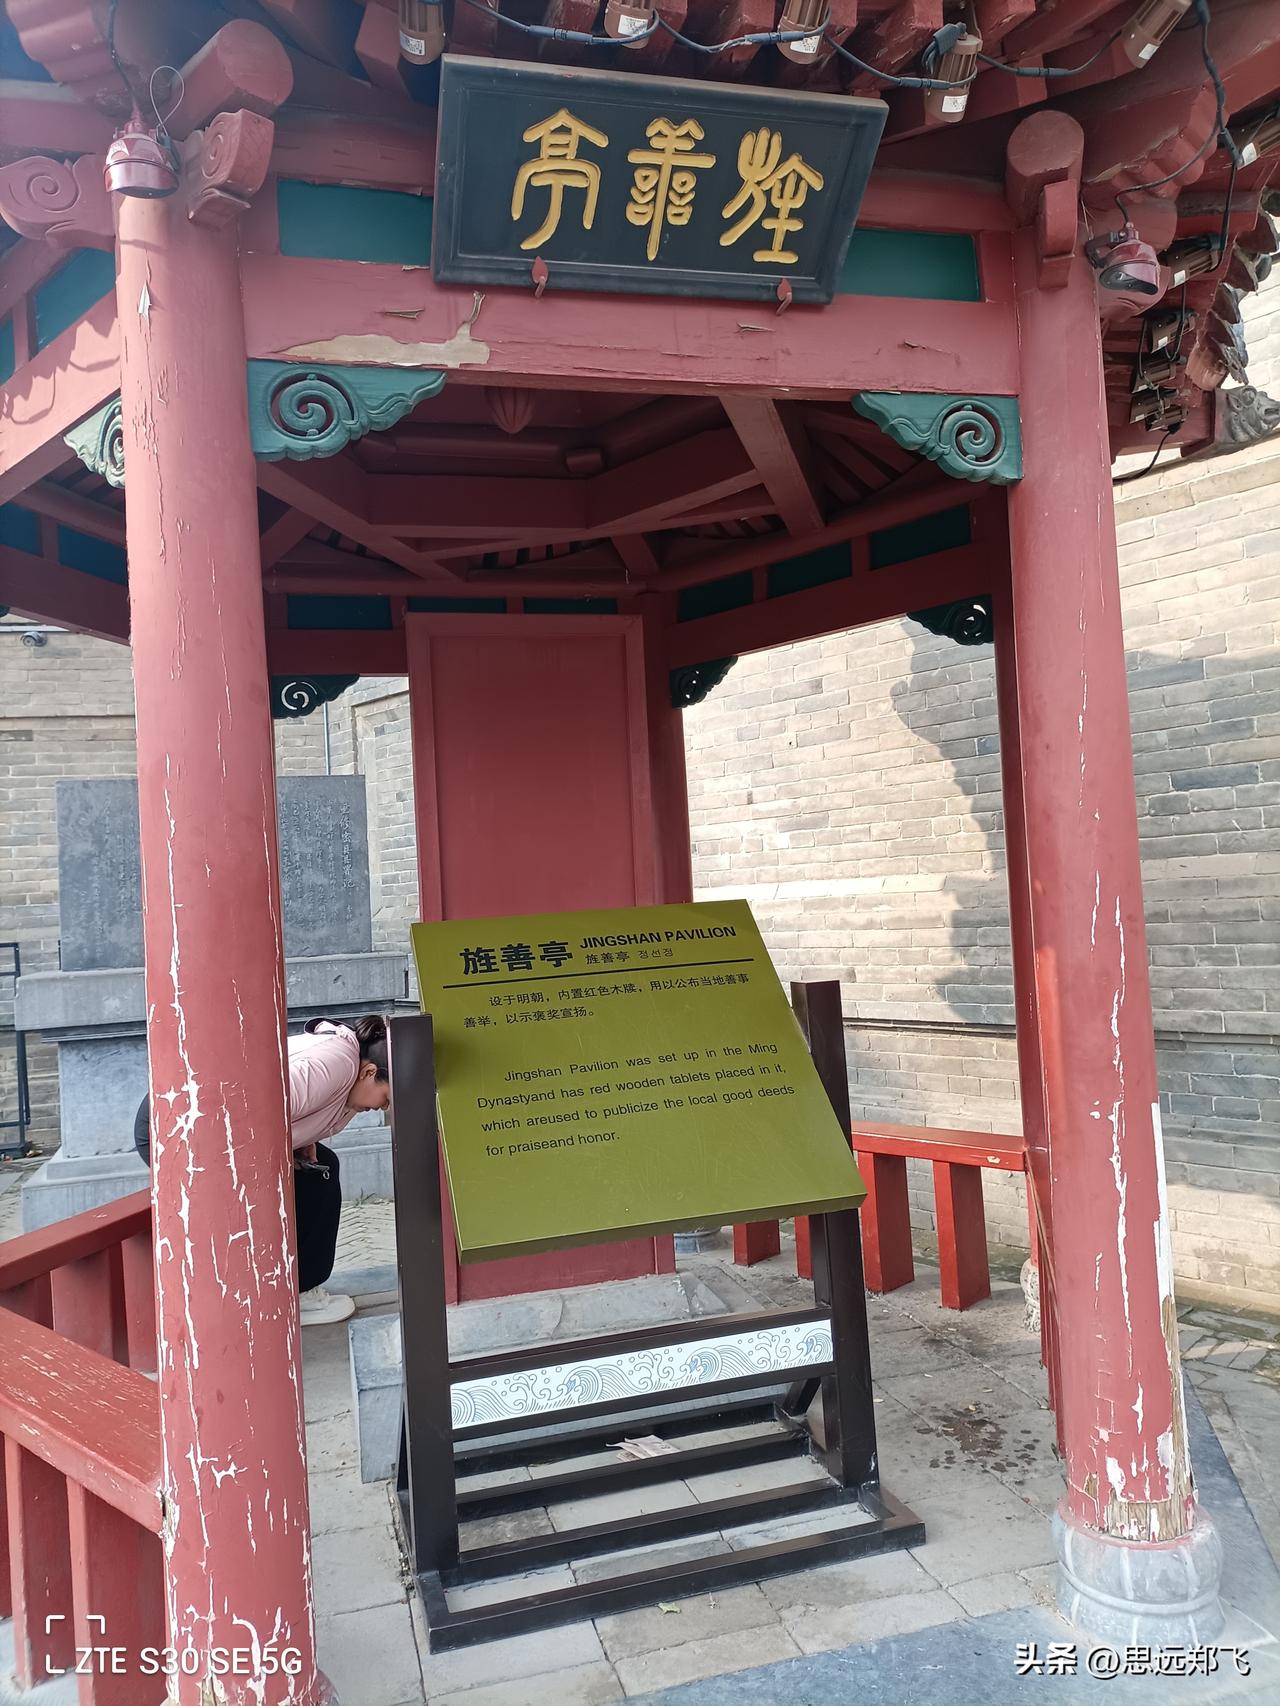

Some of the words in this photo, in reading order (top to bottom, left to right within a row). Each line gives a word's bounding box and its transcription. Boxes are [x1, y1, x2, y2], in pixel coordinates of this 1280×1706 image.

[580, 932, 662, 949] JINGSHAN
[665, 926, 737, 942] PAVILION
[459, 940, 573, 975] 旌善亭
[585, 950, 630, 965] 旌善亭
[504, 1067, 562, 1082] Jingshan
[569, 1059, 619, 1074] Pavilion
[626, 1056, 651, 1067] was
[658, 1052, 677, 1063] set
[684, 1050, 699, 1061] up
[705, 1048, 717, 1058] in
[723, 1046, 743, 1057] the
[748, 1042, 778, 1055] Ming
[477, 1090, 556, 1110] Dynastyand
[561, 1087, 585, 1099] has
[590, 1082, 611, 1095] red
[616, 1077, 665, 1092] wooden
[669, 1071, 711, 1085] tablets
[715, 1066, 755, 1082] placed
[759, 1063, 771, 1075] in
[481, 1117, 521, 1132] which
[526, 1110, 580, 1128] areused
[584, 1108, 598, 1120] to
[603, 1099, 659, 1119] publicize
[663, 1097, 684, 1109] the
[688, 1092, 718, 1106] local
[722, 1088, 753, 1104] good
[757, 1084, 795, 1098] deeds
[486, 1144, 505, 1157] for
[508, 1135, 575, 1156] praiseand
[577, 1130, 621, 1145] honor.
